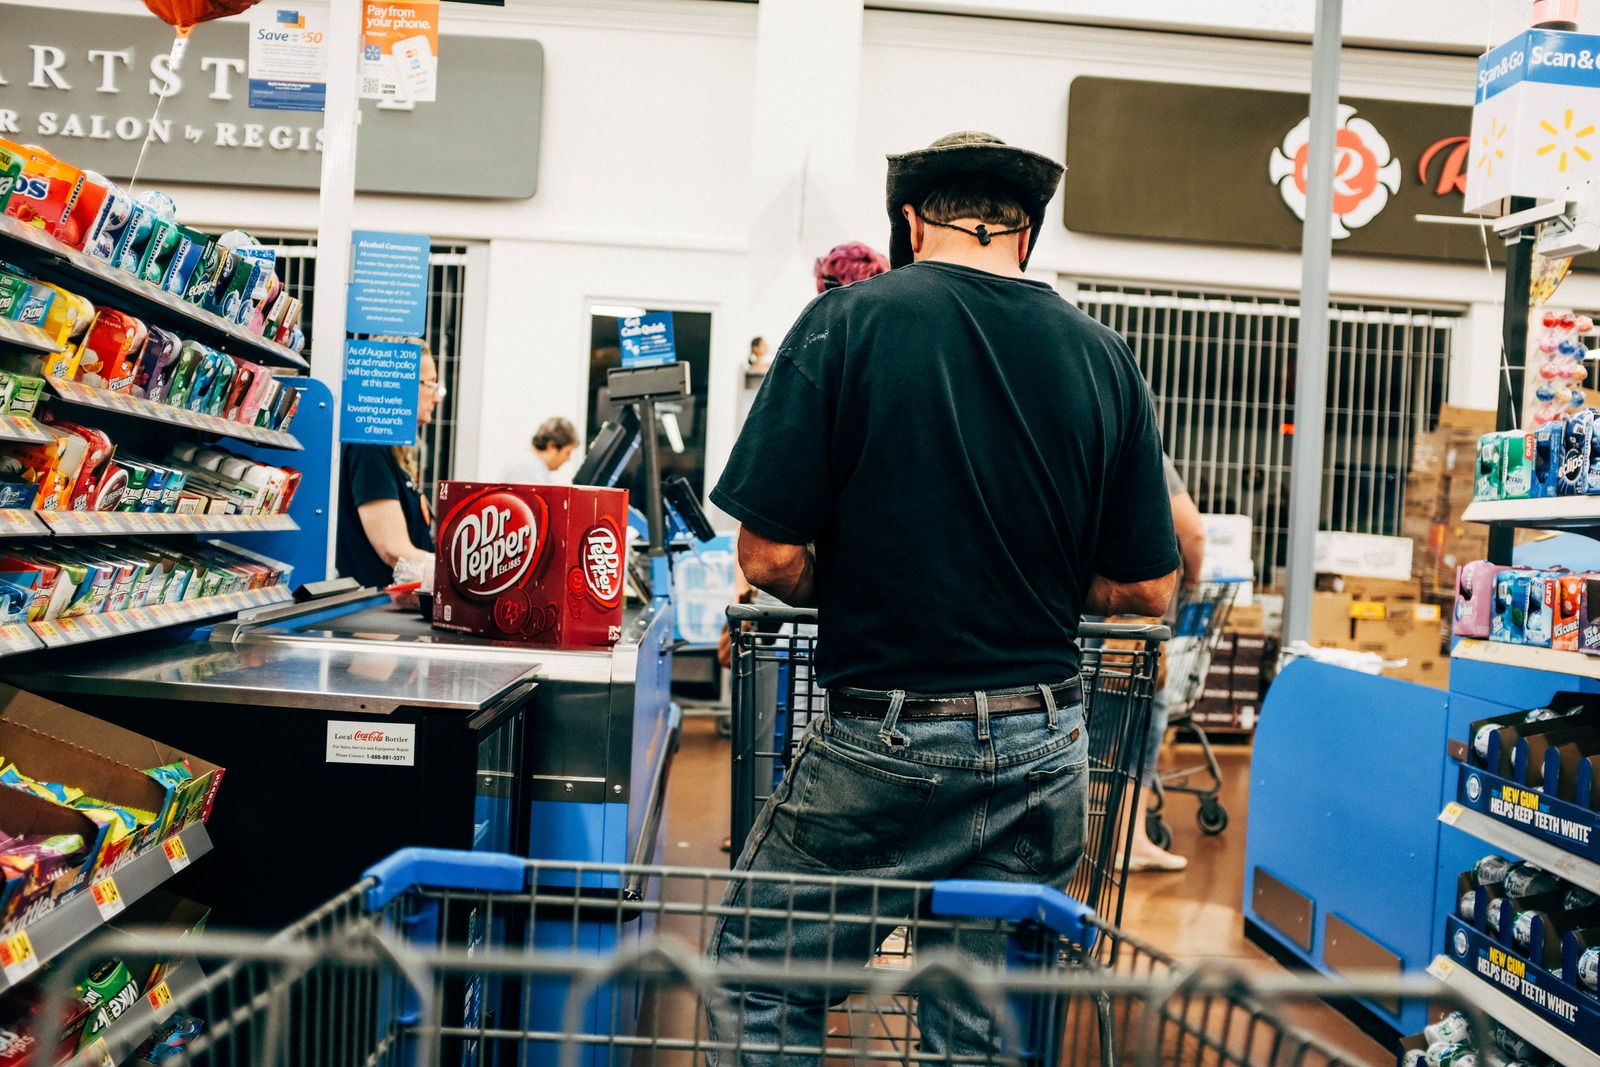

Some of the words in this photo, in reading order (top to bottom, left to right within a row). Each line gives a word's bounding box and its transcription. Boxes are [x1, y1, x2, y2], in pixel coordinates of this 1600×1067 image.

[367, 5, 387, 18] Pay
[389, 5, 415, 18] from
[366, 18, 392, 28] your
[393, 17, 431, 31] phone.
[257, 28, 289, 41] Save
[302, 31, 323, 44] $50
[38, 111, 174, 145] SALON
[185, 124, 203, 144] by
[60, 175, 85, 224] mentos
[122, 212, 143, 255] mentos
[147, 225, 167, 268] mentos
[359, 240, 385, 249] Alcohol
[170, 240, 189, 279] mentos
[621, 326, 642, 337] Cash
[641, 322, 666, 334] Quick
[624, 317, 641, 327] Get
[348, 347, 358, 355] As
[358, 347, 366, 356] of
[366, 349, 392, 358] August
[400, 351, 417, 360] 2016
[362, 358, 371, 366] ad
[371, 358, 395, 368] match
[395, 361, 416, 371] policy
[348, 367, 360, 376] will
[360, 368, 370, 376] be
[370, 368, 416, 380] discontinued
[362, 379, 368, 387] at
[369, 378, 382, 388] this
[358, 394, 384, 404] Instead
[348, 404, 378, 415] lowering
[392, 408, 412, 416] prices
[366, 415, 402, 425] thousands
[364, 424, 374, 434] of
[440, 482, 448, 496] 24
[480, 504, 511, 547] Dr
[459, 512, 531, 585] Pepper
[587, 535, 617, 595] Pepper
[603, 552, 620, 579] Dr
[205, 773, 220, 806] SHARE
[1502, 785, 1520, 803] NEW
[1520, 790, 1539, 811] GUM
[1490, 797, 1514, 819] HELPS
[1514, 804, 1534, 826] KEEP
[1534, 809, 1560, 834] TEETH
[1489, 946, 1506, 966] NEW
[1507, 954, 1526, 979] GUM
[1478, 956, 1500, 981] HELPS
[1500, 967, 1520, 990] KEEP
[1520, 978, 1546, 1008] TEETH
